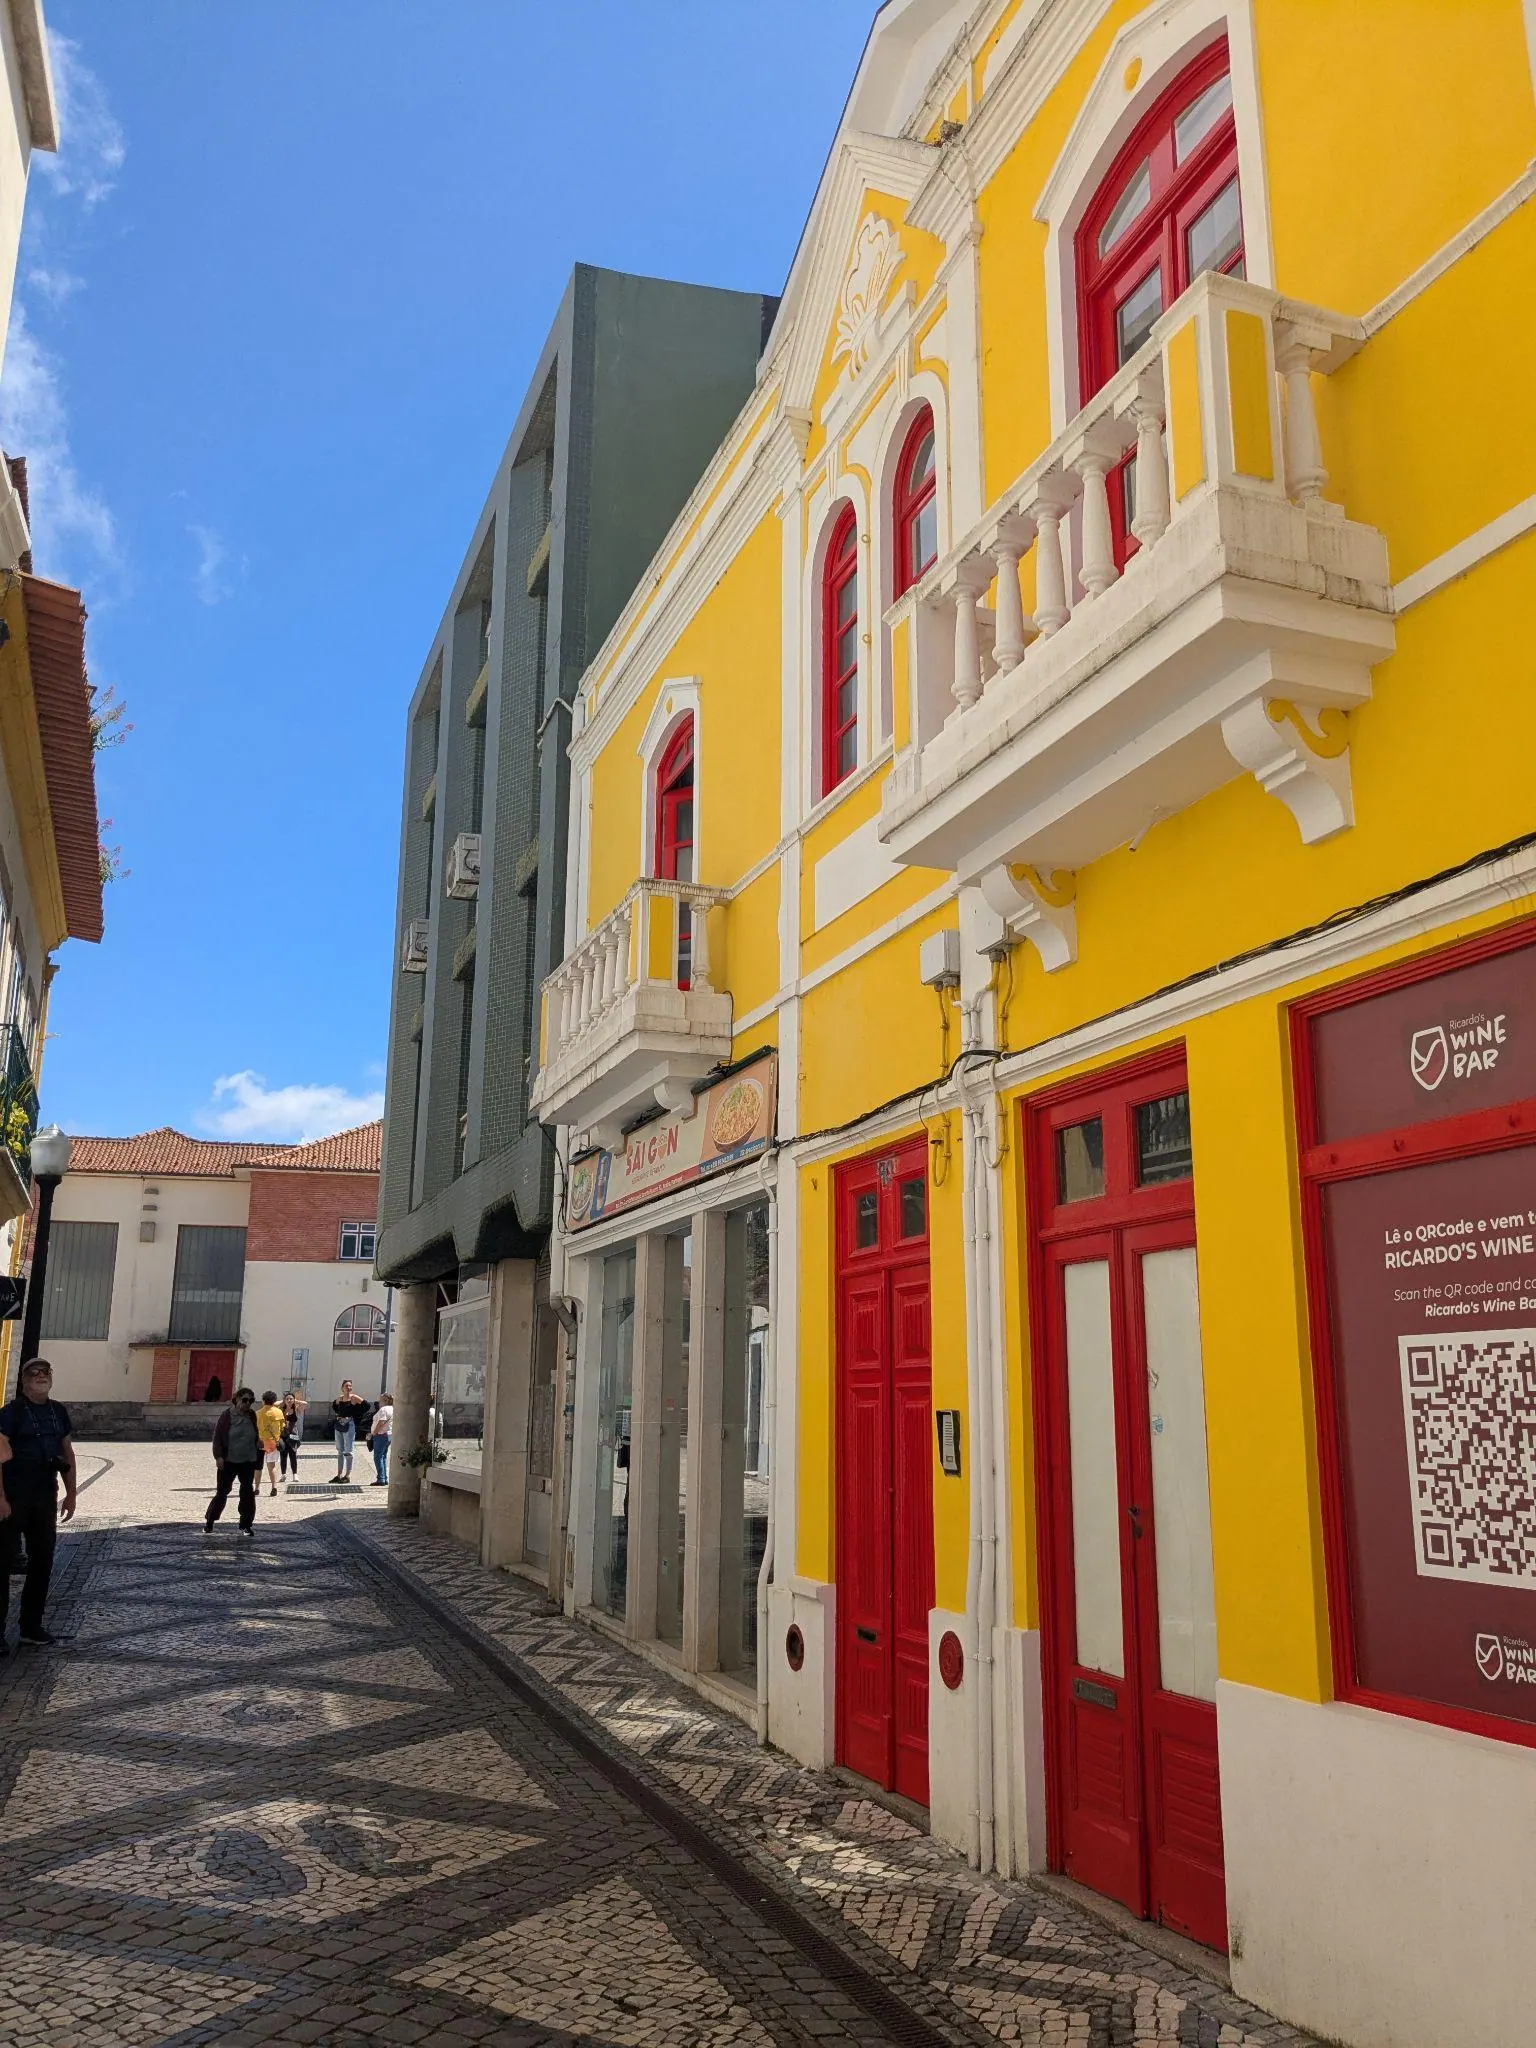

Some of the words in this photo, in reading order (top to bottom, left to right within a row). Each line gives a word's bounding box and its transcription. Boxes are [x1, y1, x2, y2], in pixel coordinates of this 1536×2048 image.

[1449, 1012, 1485, 1029] Ricardo's
[1450, 1014, 1507, 1051] WINE
[1453, 1049, 1499, 1078] BAR
[1385, 1228, 1401, 1245] Lê
[1403, 1230, 1413, 1242] o
[1415, 1219, 1474, 1242] QRCode
[1477, 1219, 1487, 1232] e
[1490, 1213, 1524, 1230] vem
[1527, 1210, 1536, 1225] t
[1385, 1241, 1478, 1269] RICARDO'S
[1481, 1234, 1534, 1258] WINE
[1394, 1289, 1421, 1302] Scan
[1423, 1286, 1442, 1299] the
[1444, 1283, 1462, 1299] QR
[1464, 1280, 1494, 1296] code
[1496, 1276, 1521, 1292] and
[1425, 1301, 1480, 1317] Ricardo's
[1482, 1298, 1516, 1313] Wine
[1503, 1645, 1536, 1664] WIN
